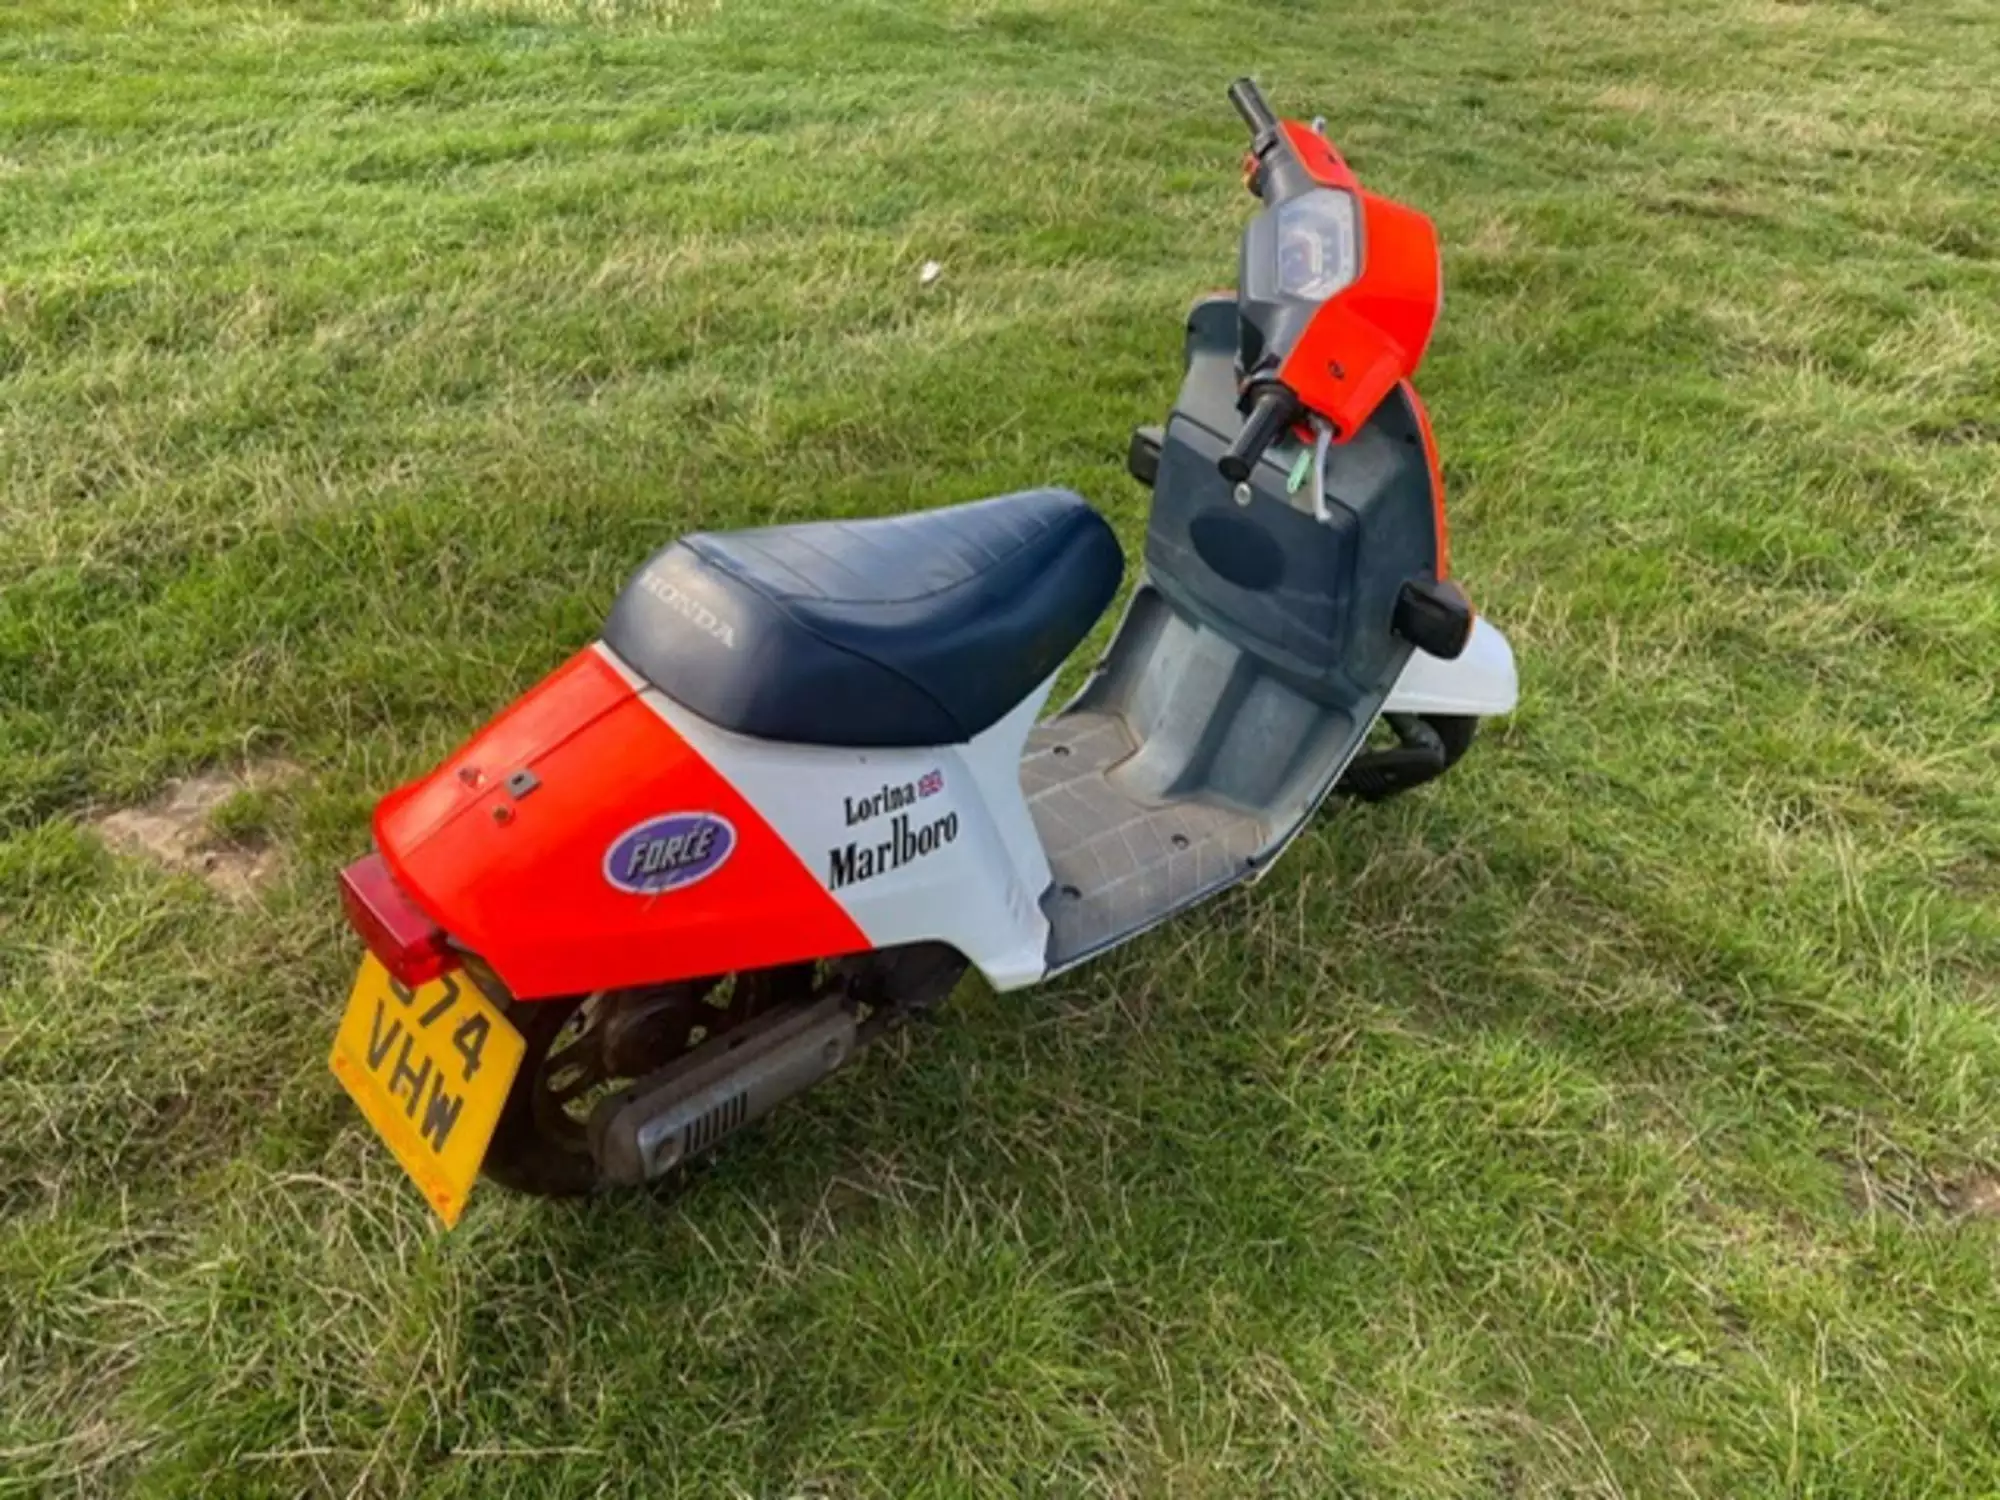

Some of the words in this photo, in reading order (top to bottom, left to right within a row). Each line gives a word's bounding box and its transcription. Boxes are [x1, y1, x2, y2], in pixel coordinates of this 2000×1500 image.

[641, 571, 734, 649] HONDA
[844, 782, 917, 826] Lorina
[626, 825, 720, 881] FORCE
[828, 811, 958, 891] Marlboro
[366, 998, 463, 1154] VHW
